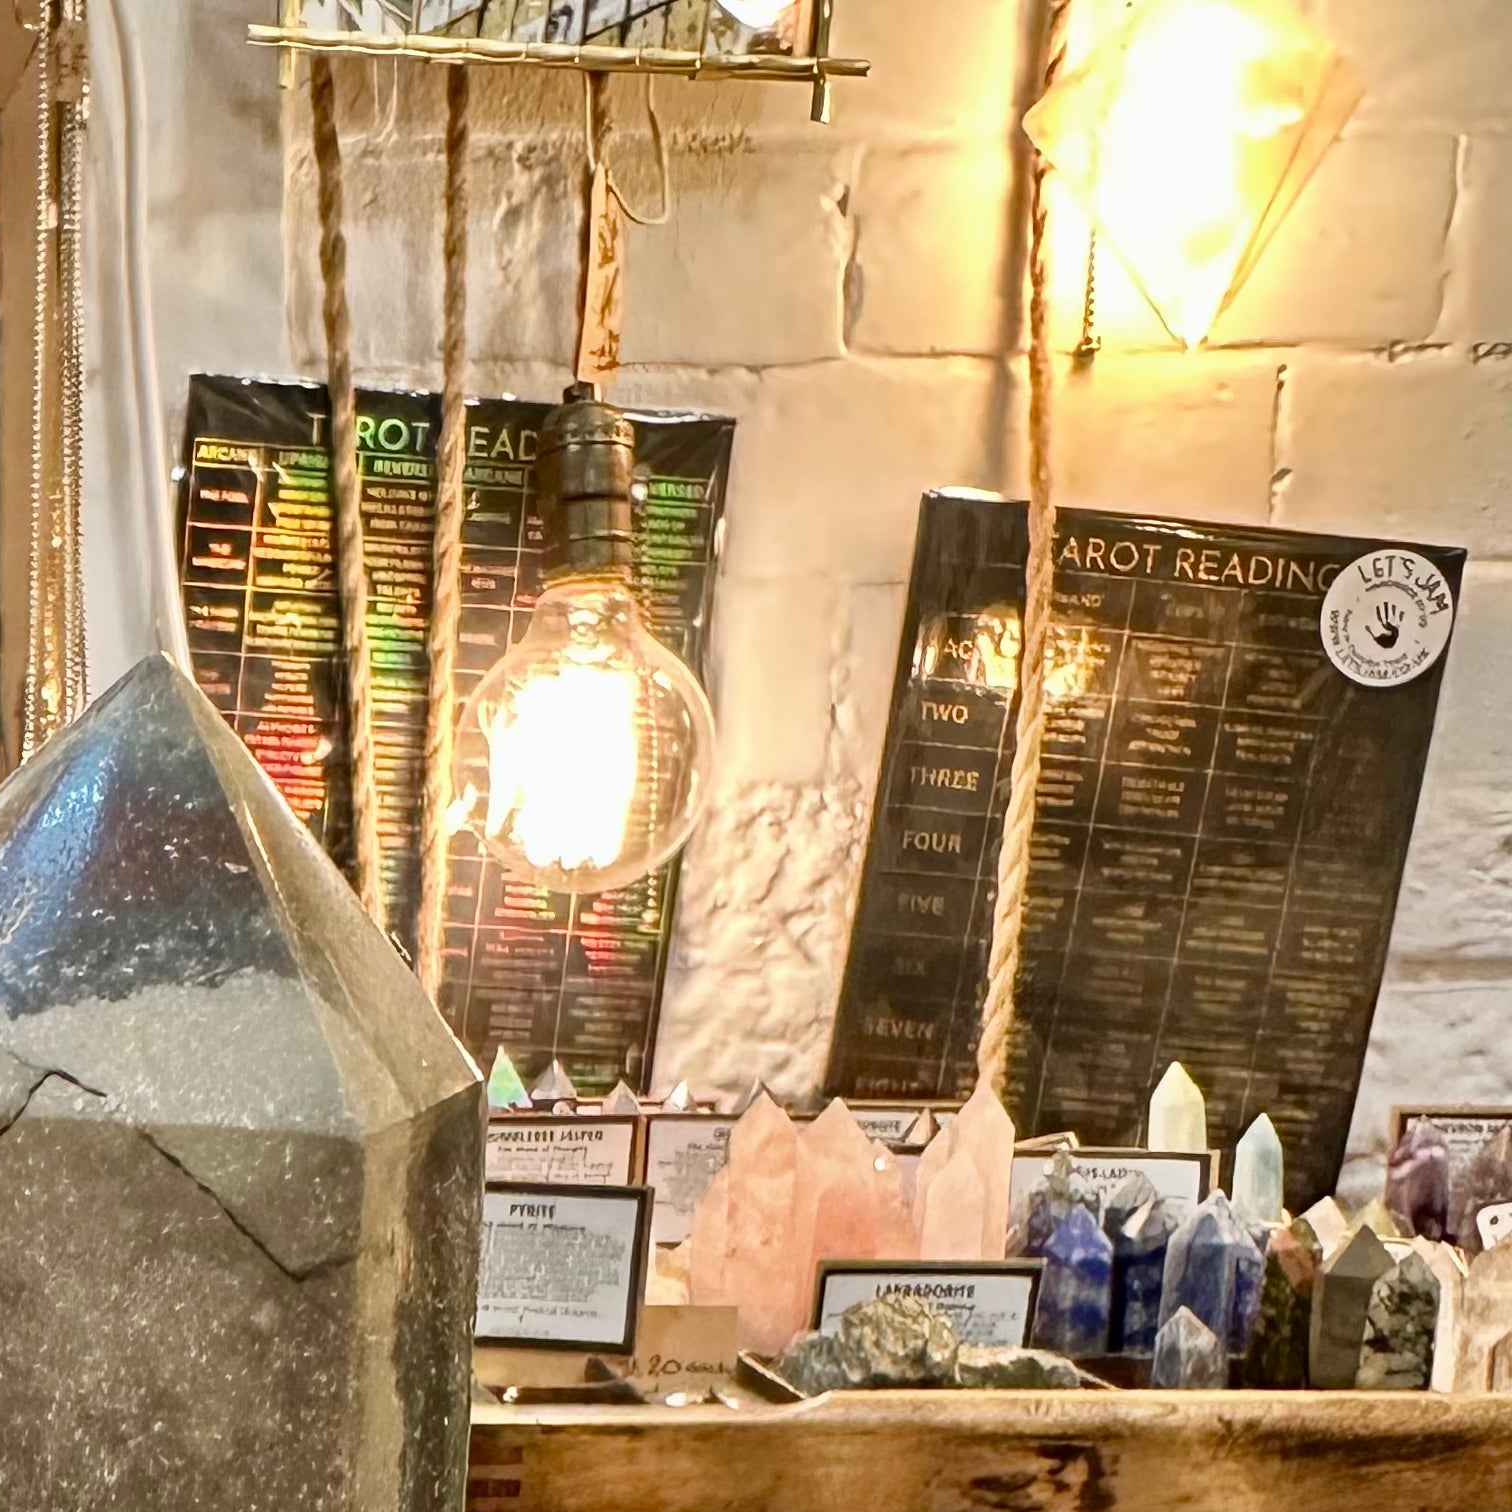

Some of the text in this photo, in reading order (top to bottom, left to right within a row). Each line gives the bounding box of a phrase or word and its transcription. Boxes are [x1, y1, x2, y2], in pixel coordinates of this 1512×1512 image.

[306, 411, 431, 451] TROT
[1052, 531, 1161, 574] AROT
[920, 701, 969, 724] TWO
[909, 765, 980, 793] THREE
[901, 829, 962, 854] FOUR
[509, 1204, 557, 1220] PYRITE
